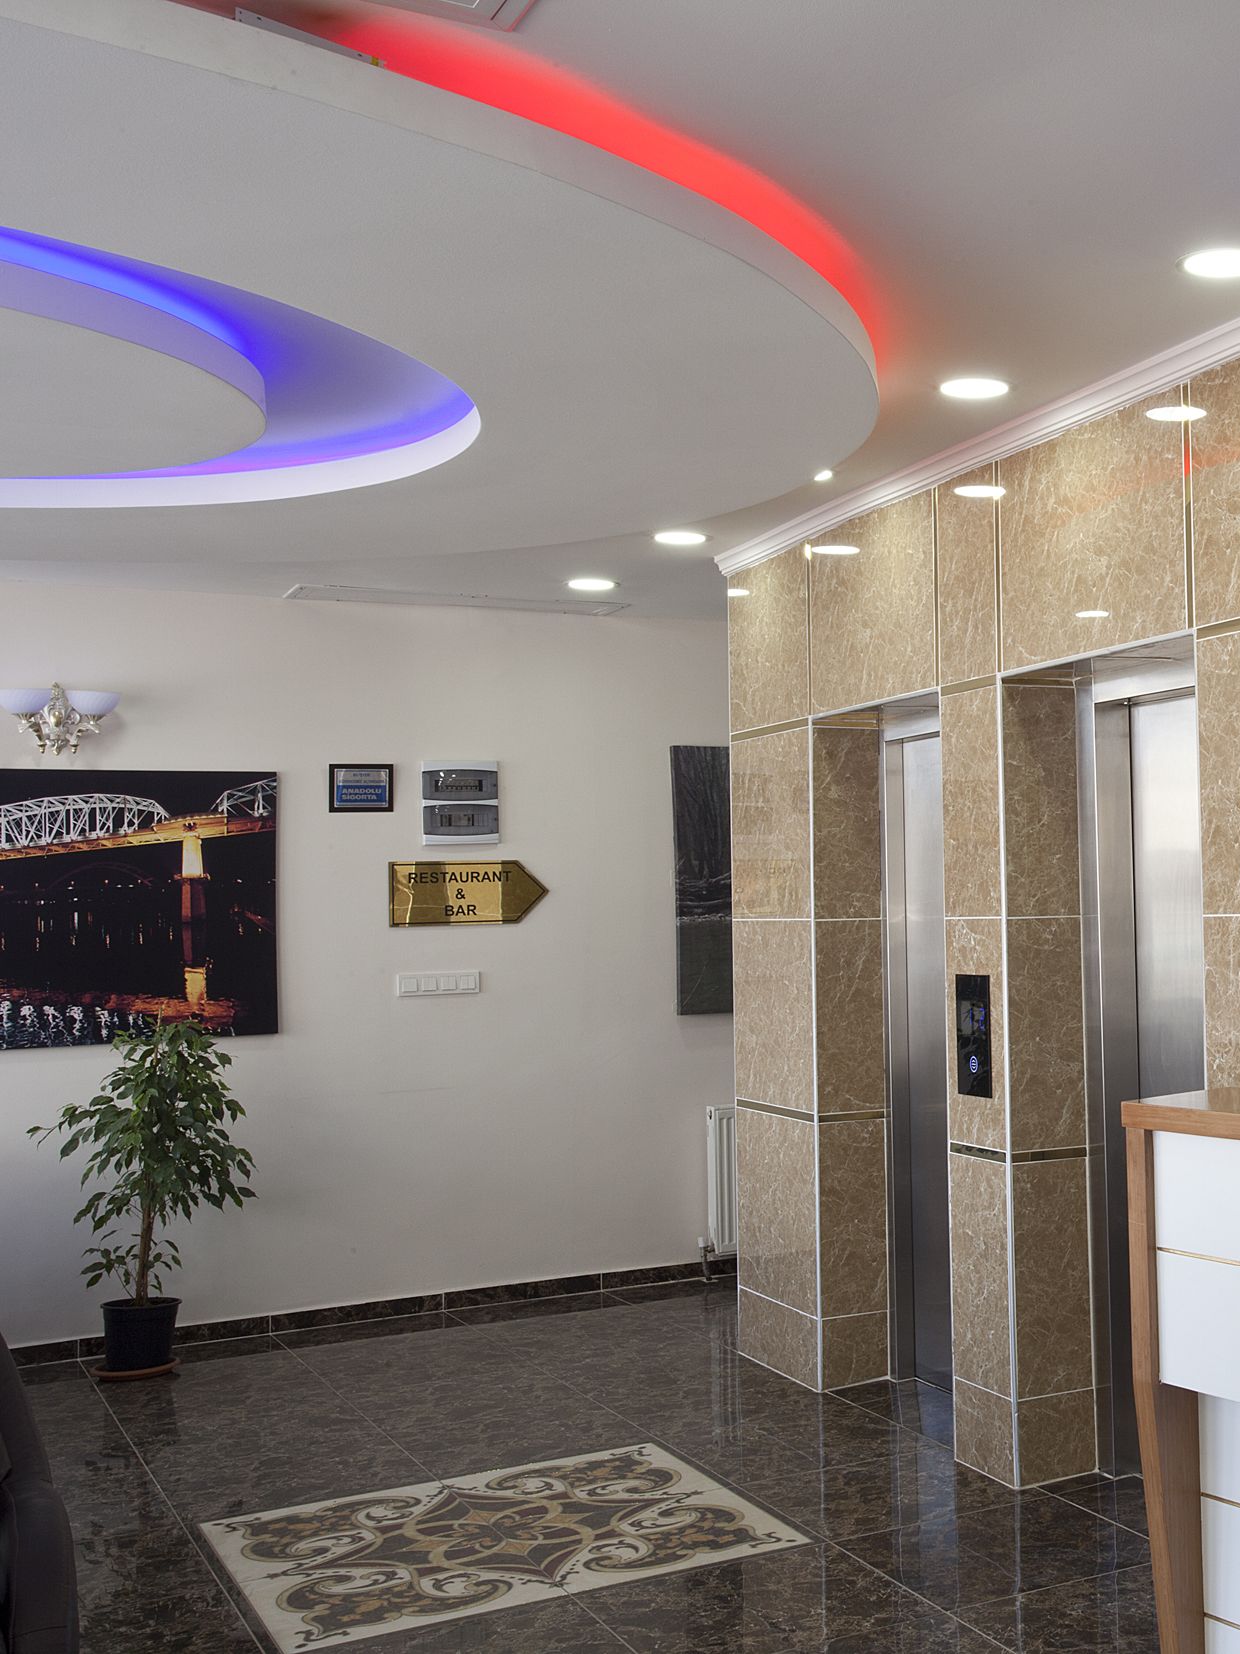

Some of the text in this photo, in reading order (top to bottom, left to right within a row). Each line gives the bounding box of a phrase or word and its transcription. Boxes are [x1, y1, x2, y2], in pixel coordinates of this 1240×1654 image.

[408, 870, 512, 884] RESTAURANT
[455, 888, 466, 900] &
[444, 904, 477, 917] BAR
